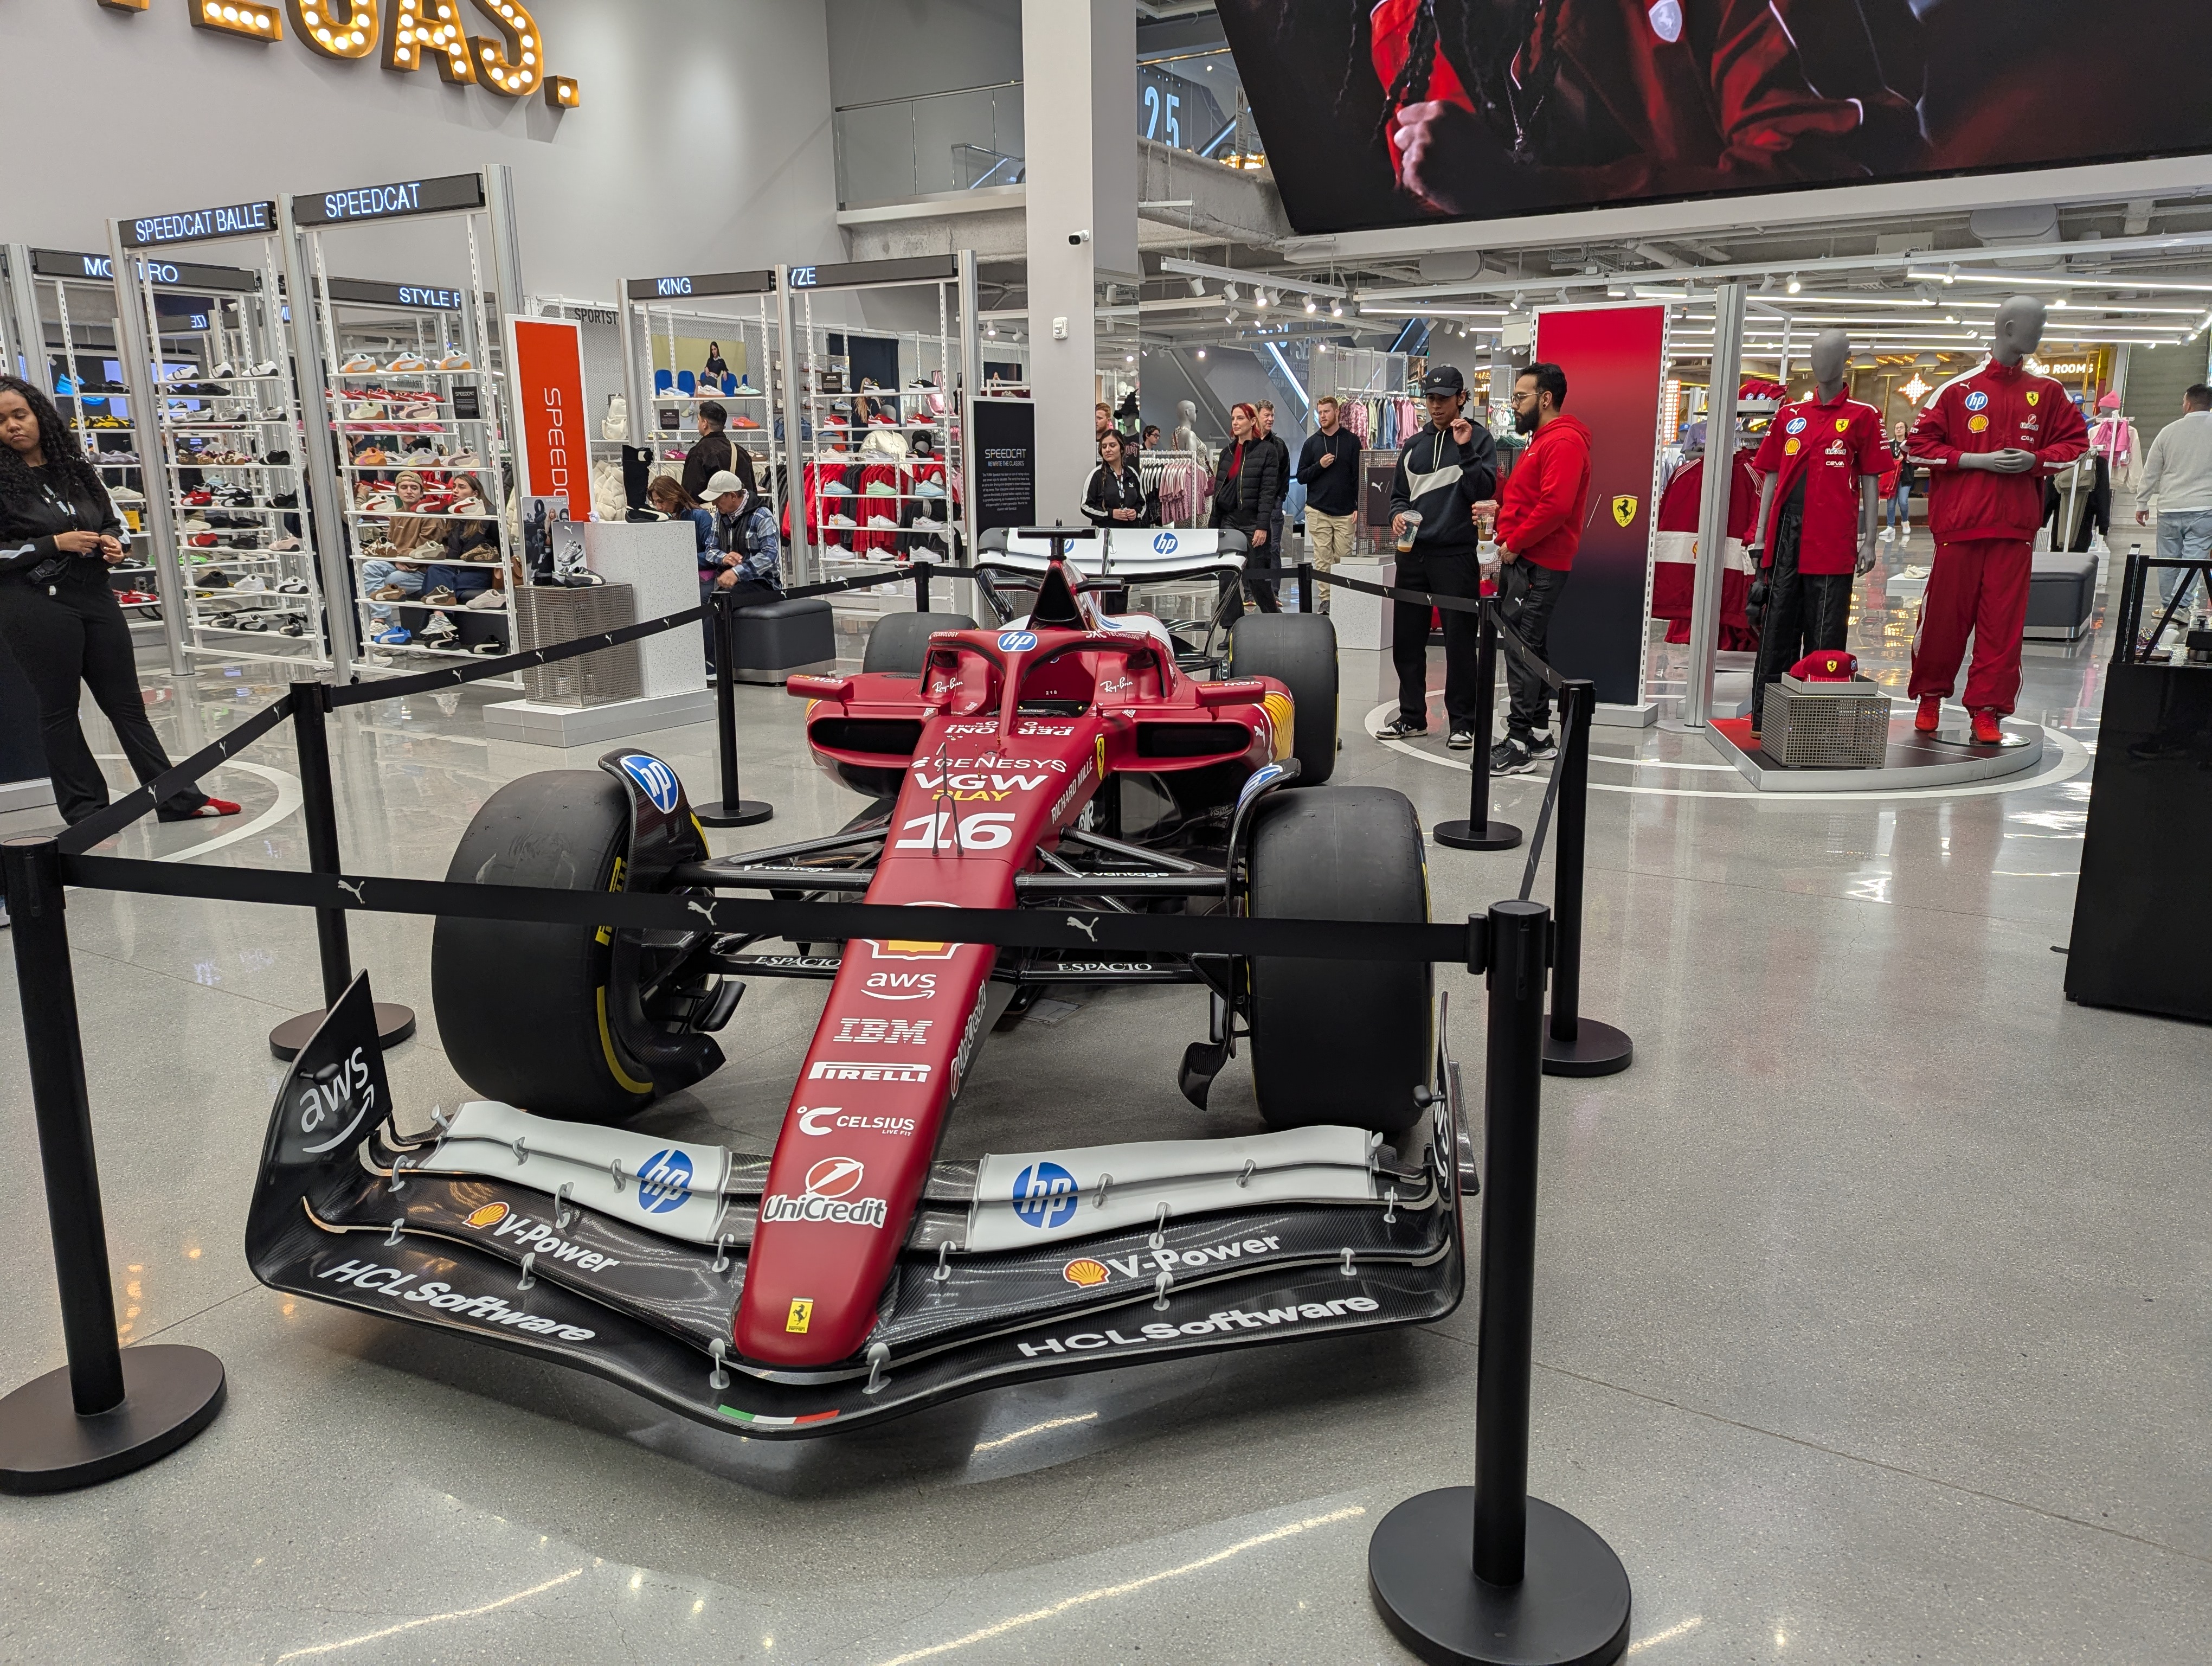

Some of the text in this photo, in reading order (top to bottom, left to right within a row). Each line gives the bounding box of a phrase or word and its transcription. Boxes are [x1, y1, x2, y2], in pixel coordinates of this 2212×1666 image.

[1144, 86, 1179, 148] 25
[325, 183, 420, 217] SPEEDCAT
[136, 203, 268, 241] SPEEDCAT BALLE
[83, 257, 178, 282] MOTRO
[399, 287, 450, 307] STYLE
[658, 278, 691, 296] KING
[1969, 392, 1985, 411] hp
[1788, 418, 1804, 434] hp
[544, 387, 570, 505] SPEEDC
[985, 449, 1026, 459] SPEEDCAT
[1156, 533, 1174, 554] hp
[1002, 631, 1033, 651] hp
[931, 677, 963, 693] Ray-Ban
[1100, 677, 1133, 693] Ray-Ban
[934, 757, 1067, 773] GENESYS
[915, 773, 1049, 790] VGW
[1051, 779, 1077, 824] RICHARD
[1077, 755, 1093, 787] MILLE
[932, 790, 1013, 801] PLAY
[895, 812, 1016, 850] 16
[754, 956, 842, 967] ESPACIO
[1058, 962, 1153, 972] ESPACIO
[867, 972, 937, 989] aws
[832, 1018, 933, 1045] IBM
[807, 1061, 932, 1083] PIRELLI
[299, 1047, 369, 1132] aws
[837, 1115, 916, 1131] CELSIUS
[642, 1150, 688, 1213] hp
[1024, 1162, 1071, 1228] hp
[762, 1195, 887, 1227] UniCredit
[492, 1214, 620, 1272] V-Power
[1107, 1234, 1281, 1279] V-Power
[318, 1259, 596, 1341] HCLSoftware
[1017, 1296, 1379, 1357] HCLSoftware
